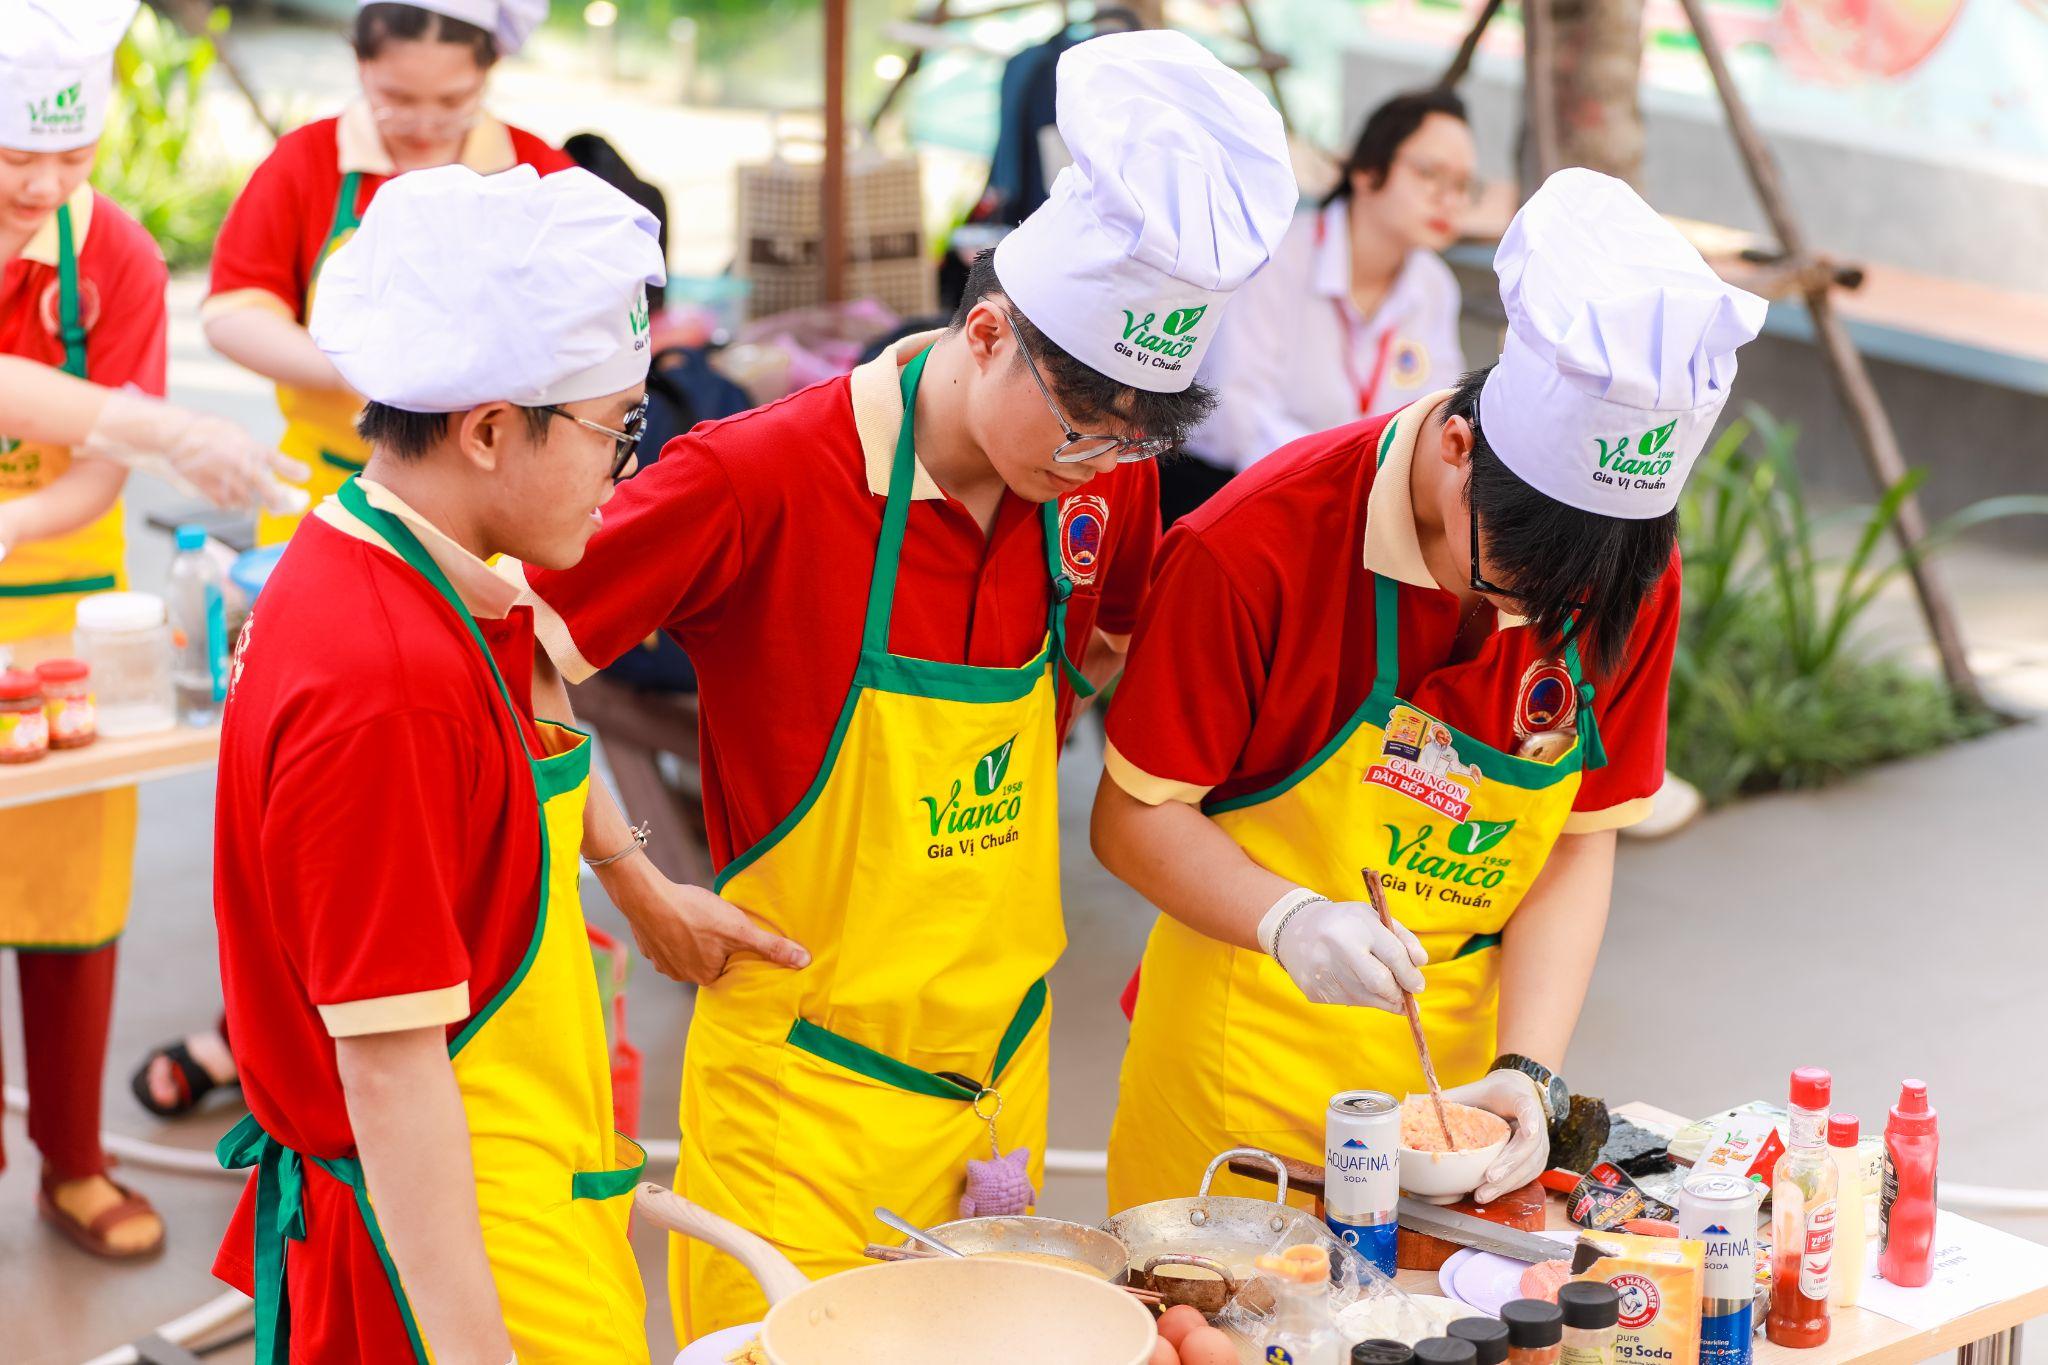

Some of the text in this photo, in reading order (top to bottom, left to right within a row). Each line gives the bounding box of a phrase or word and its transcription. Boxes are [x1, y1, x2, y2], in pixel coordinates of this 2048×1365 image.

[1122, 309, 1194, 358] Vianco
[1113, 342, 1182, 371] Gia Vị Chuẩn
[1593, 437, 1672, 476] Vianco
[1592, 471, 1666, 490] Gia Vị Chuẩn
[1002, 781, 1023, 796] 1958
[1372, 768, 1463, 817] ĐẦU BẾP ẤN ĐỘ
[1410, 769, 1426, 781] RI
[1427, 775, 1466, 800] NGON
[918, 779, 1021, 837] Vianco
[927, 825, 1019, 859] Gia Vị Chuẩn
[1383, 825, 1506, 889] Vianco
[1482, 856, 1511, 867] 1958
[1380, 873, 1491, 909] Gia Vị Chuẩn
[1327, 1149, 1389, 1172] AQUAFINA
[1344, 1175, 1368, 1183] SODA
[1704, 1262, 1729, 1270] SODA
[1617, 1278, 1625, 1286] &
[1626, 1276, 1658, 1309] HAMMER
[1616, 1334, 1640, 1343] pure
[1636, 1345, 1672, 1359] Soda
